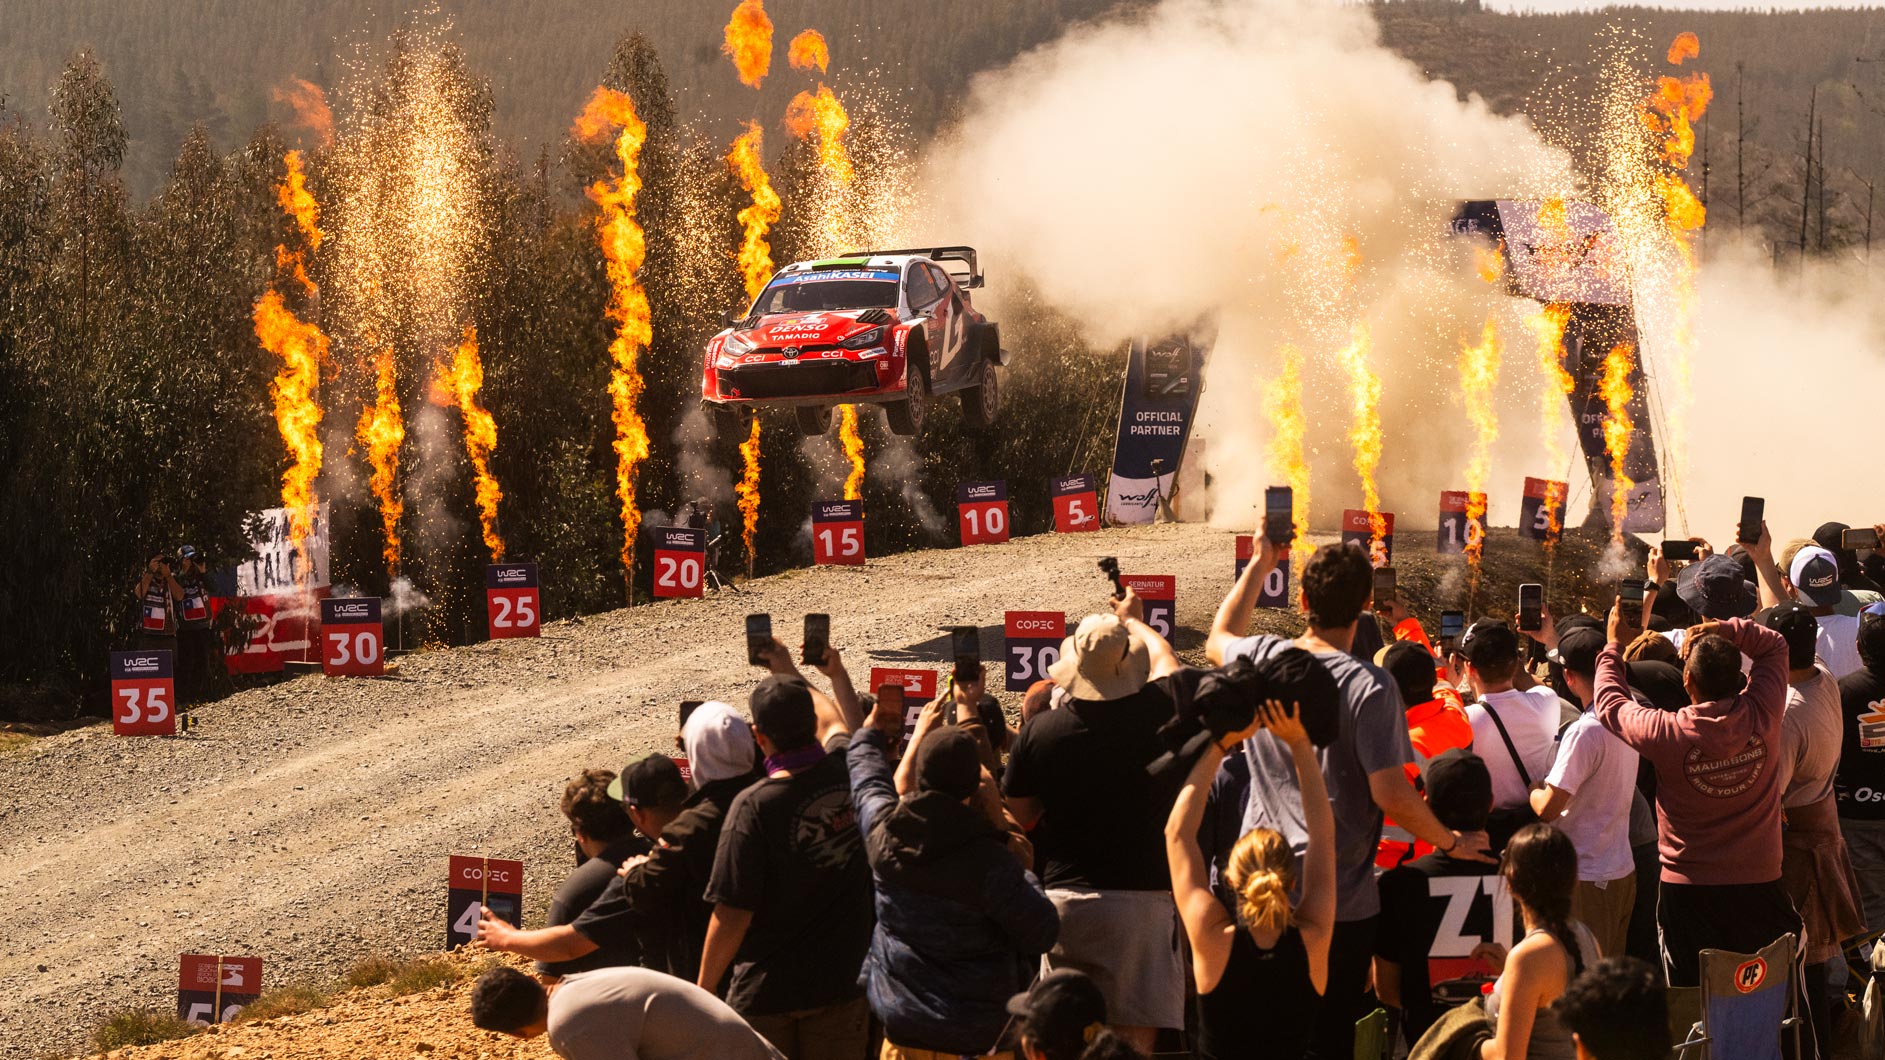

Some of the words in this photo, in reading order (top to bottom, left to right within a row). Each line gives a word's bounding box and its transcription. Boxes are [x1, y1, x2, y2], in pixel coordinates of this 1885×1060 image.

[793, 271, 875, 283] AsahiKASEI
[768, 323, 829, 334] DENSO
[771, 333, 820, 341] TAMADIC
[821, 350, 844, 358] CCI
[1136, 411, 1183, 422] OFFICIAL
[1130, 425, 1181, 436] PARTNER
[1592, 428, 1643, 438] PAER
[1060, 477, 1085, 488] WRC
[967, 485, 996, 494] WRC
[822, 504, 851, 513] WRC
[1068, 500, 1085, 526] 5
[964, 508, 1004, 536] 10
[1533, 504, 1550, 530] 5
[665, 532, 695, 542] WRC
[1443, 518, 1481, 545] 10
[818, 528, 860, 557] 15
[496, 569, 527, 578] WRC
[658, 557, 700, 589] 20
[334, 603, 369, 613] WRC
[493, 596, 535, 628] 25
[1016, 620, 1055, 630] COPEC
[1149, 607, 1170, 638] 5
[328, 632, 378, 666] 30
[124, 657, 159, 667] WRC
[1011, 646, 1060, 681] 30
[119, 687, 169, 724] 35
[1692, 777, 1714, 794] RIDE
[1717, 784, 1747, 796] YOUR
[1747, 763, 1763, 784] LIFE
